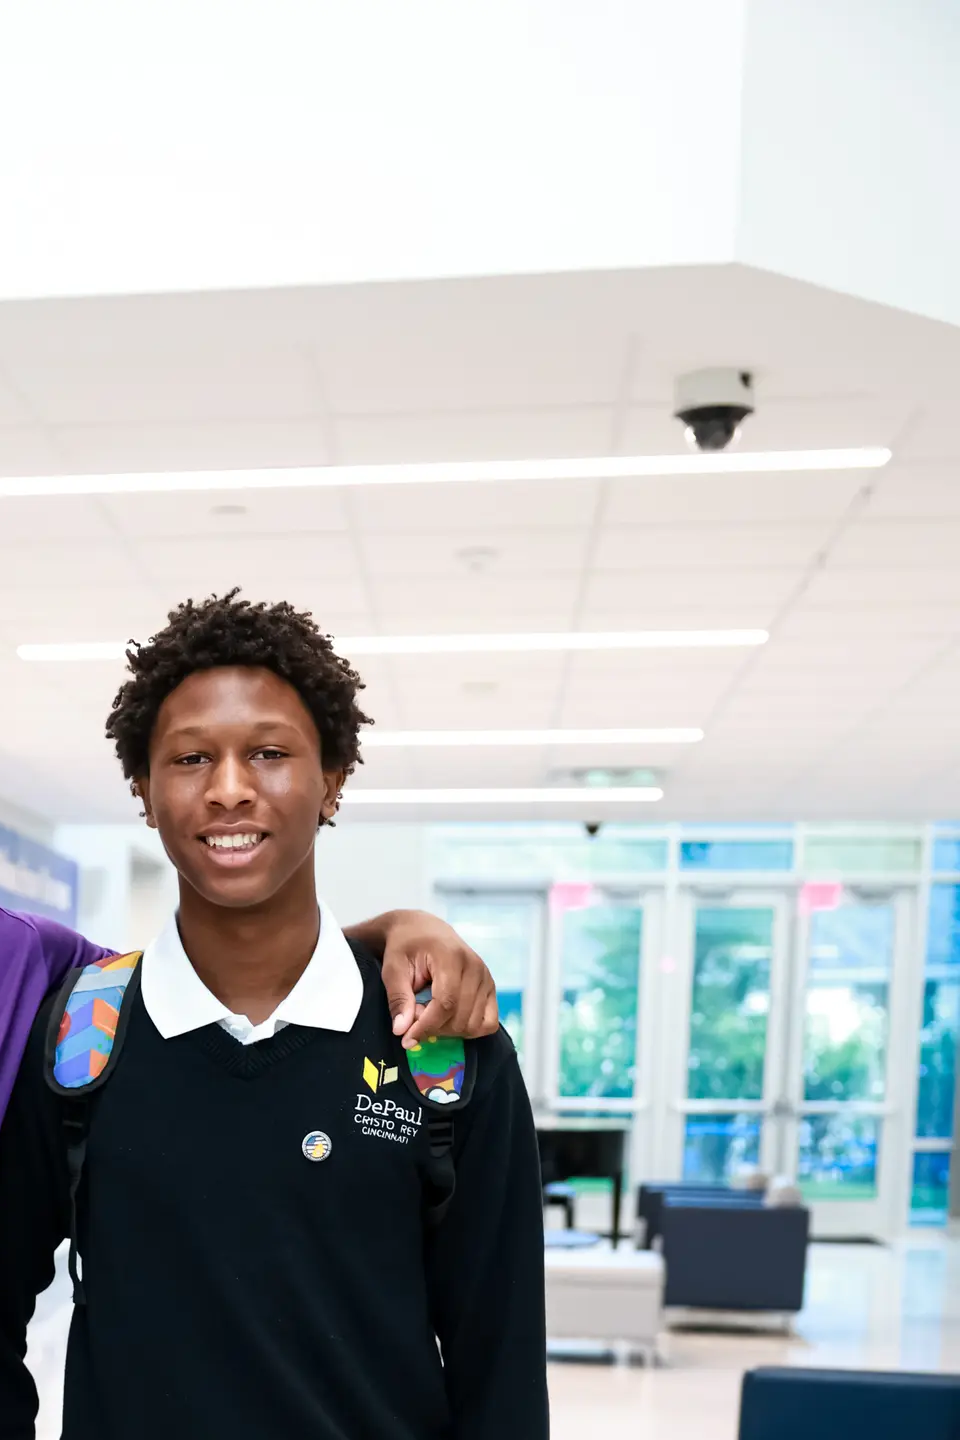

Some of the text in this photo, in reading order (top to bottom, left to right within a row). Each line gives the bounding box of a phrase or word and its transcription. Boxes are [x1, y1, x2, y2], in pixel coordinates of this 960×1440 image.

[354, 1094, 422, 1126] DePaul
[354, 1114, 418, 1137] CRISTO REY
[362, 1126, 409, 1145] CINCINNATI
